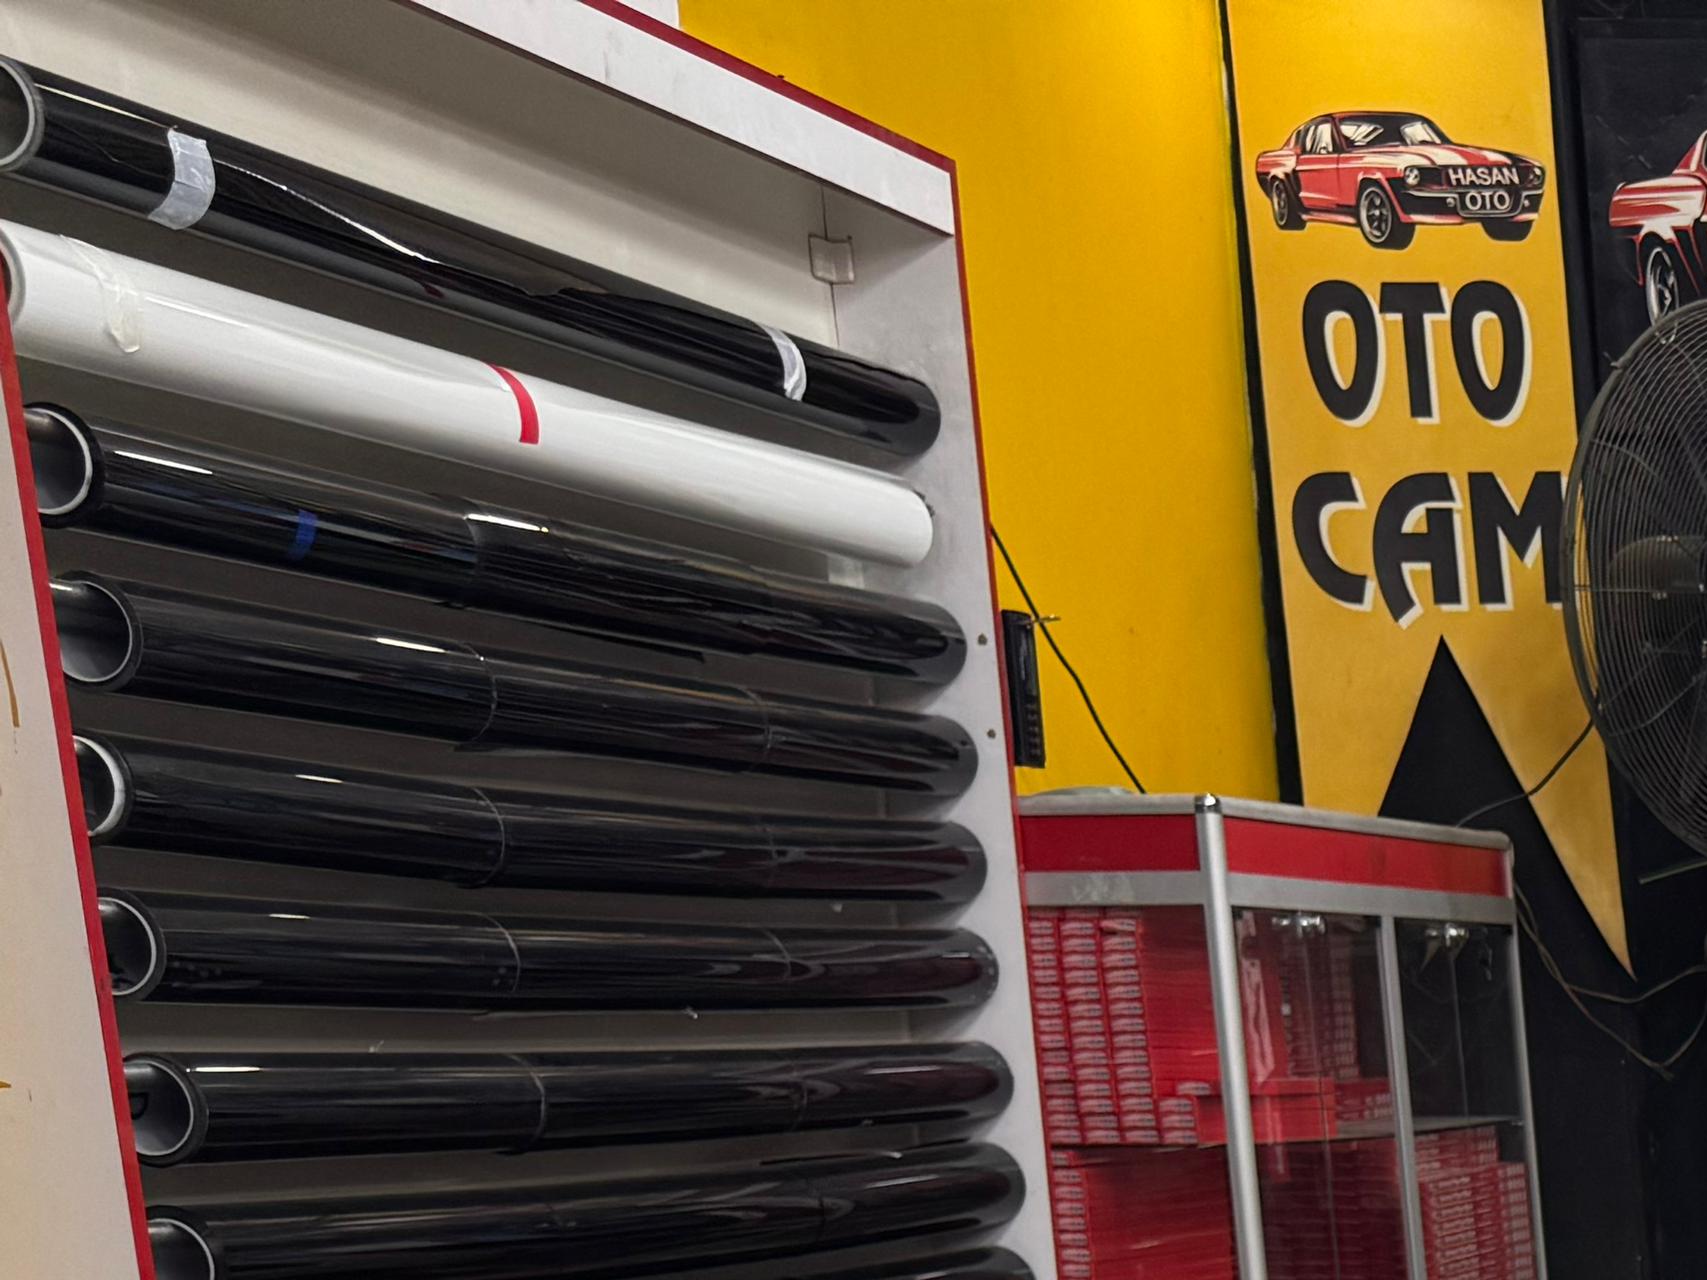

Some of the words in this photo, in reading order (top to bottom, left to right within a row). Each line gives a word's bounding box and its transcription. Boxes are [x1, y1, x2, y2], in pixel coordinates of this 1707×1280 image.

[1449, 166, 1520, 186] HASAN
[1465, 190, 1511, 211] OTO
[1302, 279, 1533, 428] OTO
[1291, 471, 1570, 631] CAM
